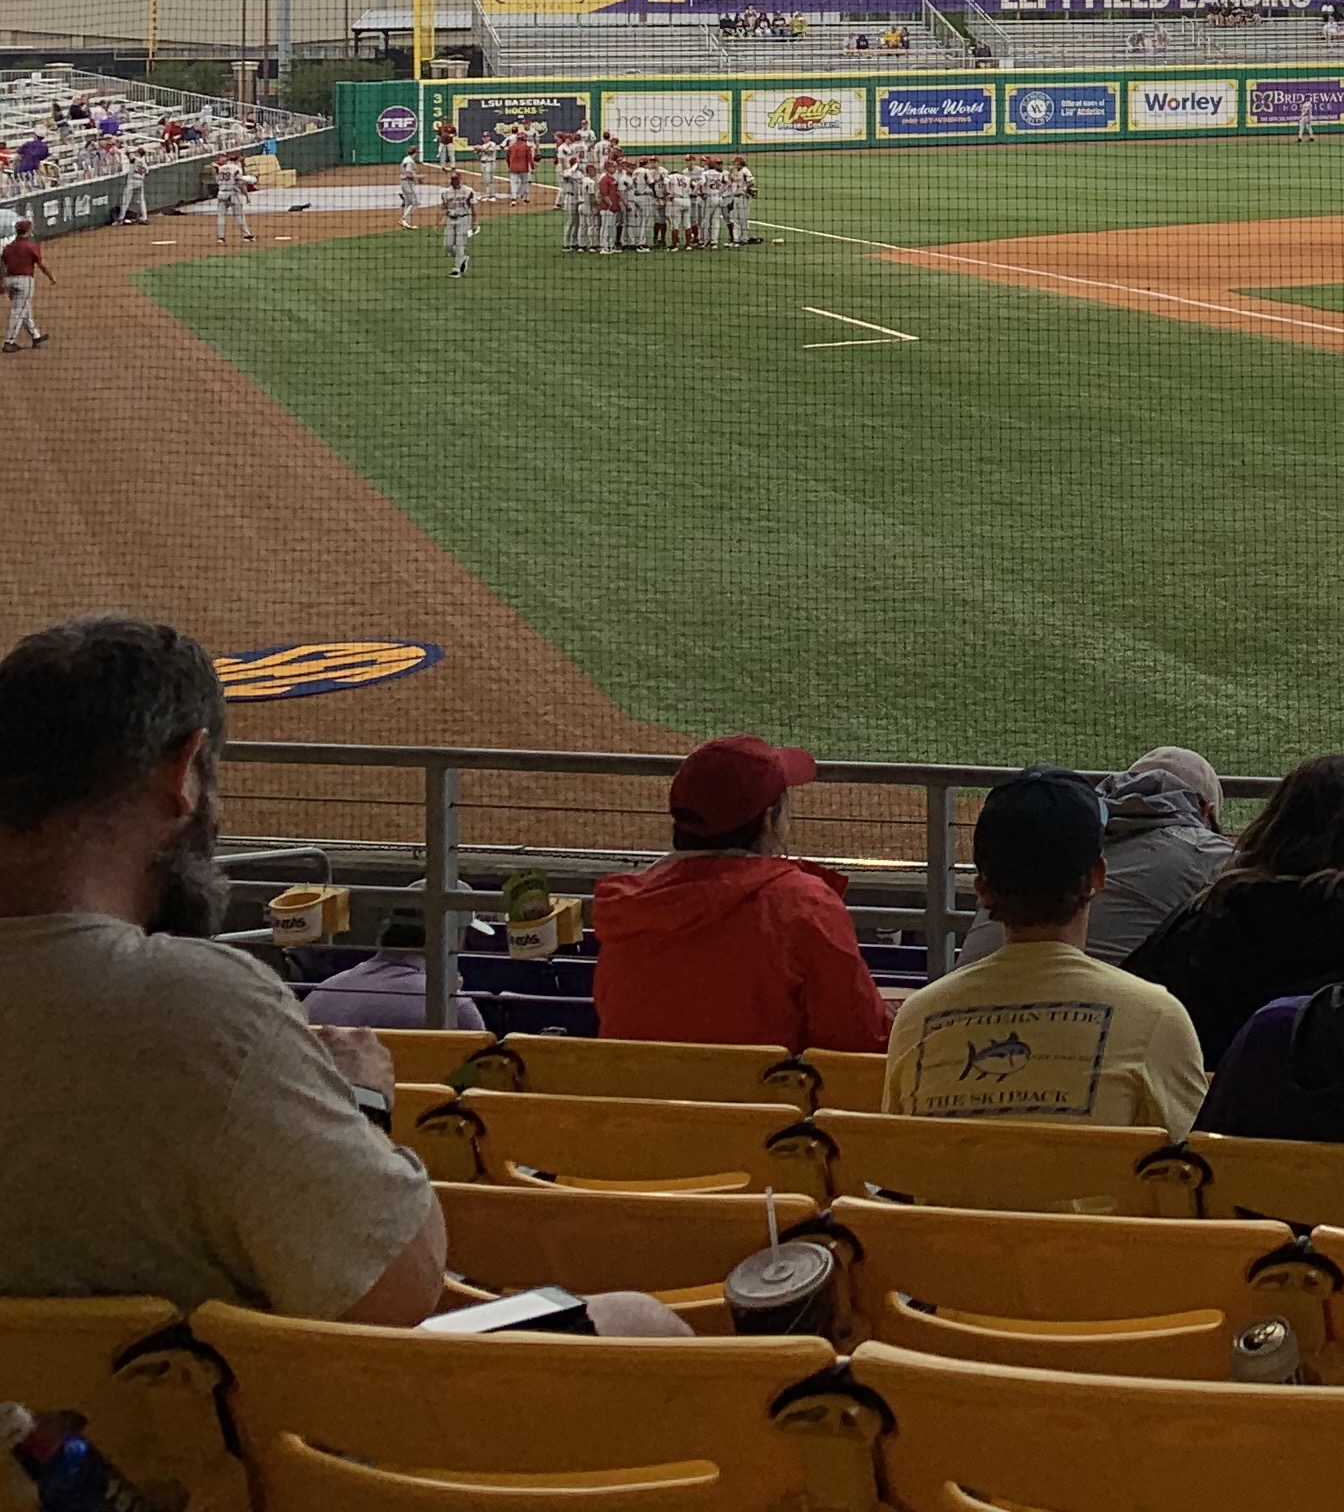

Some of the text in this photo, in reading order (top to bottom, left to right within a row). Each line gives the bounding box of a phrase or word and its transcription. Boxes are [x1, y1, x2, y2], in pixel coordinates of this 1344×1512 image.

[481, 98, 560, 108] LSU BASEBALL
[889, 99, 984, 116] Window World
[1144, 92, 1223, 115] Worley
[1283, 103, 1333, 111] HOSICE
[616, 108, 706, 133] hargrove
[768, 96, 841, 128] Andy's
[1050, 1010, 1101, 1024] TIDE
[927, 1090, 1069, 1108] THE SKIPJACK
